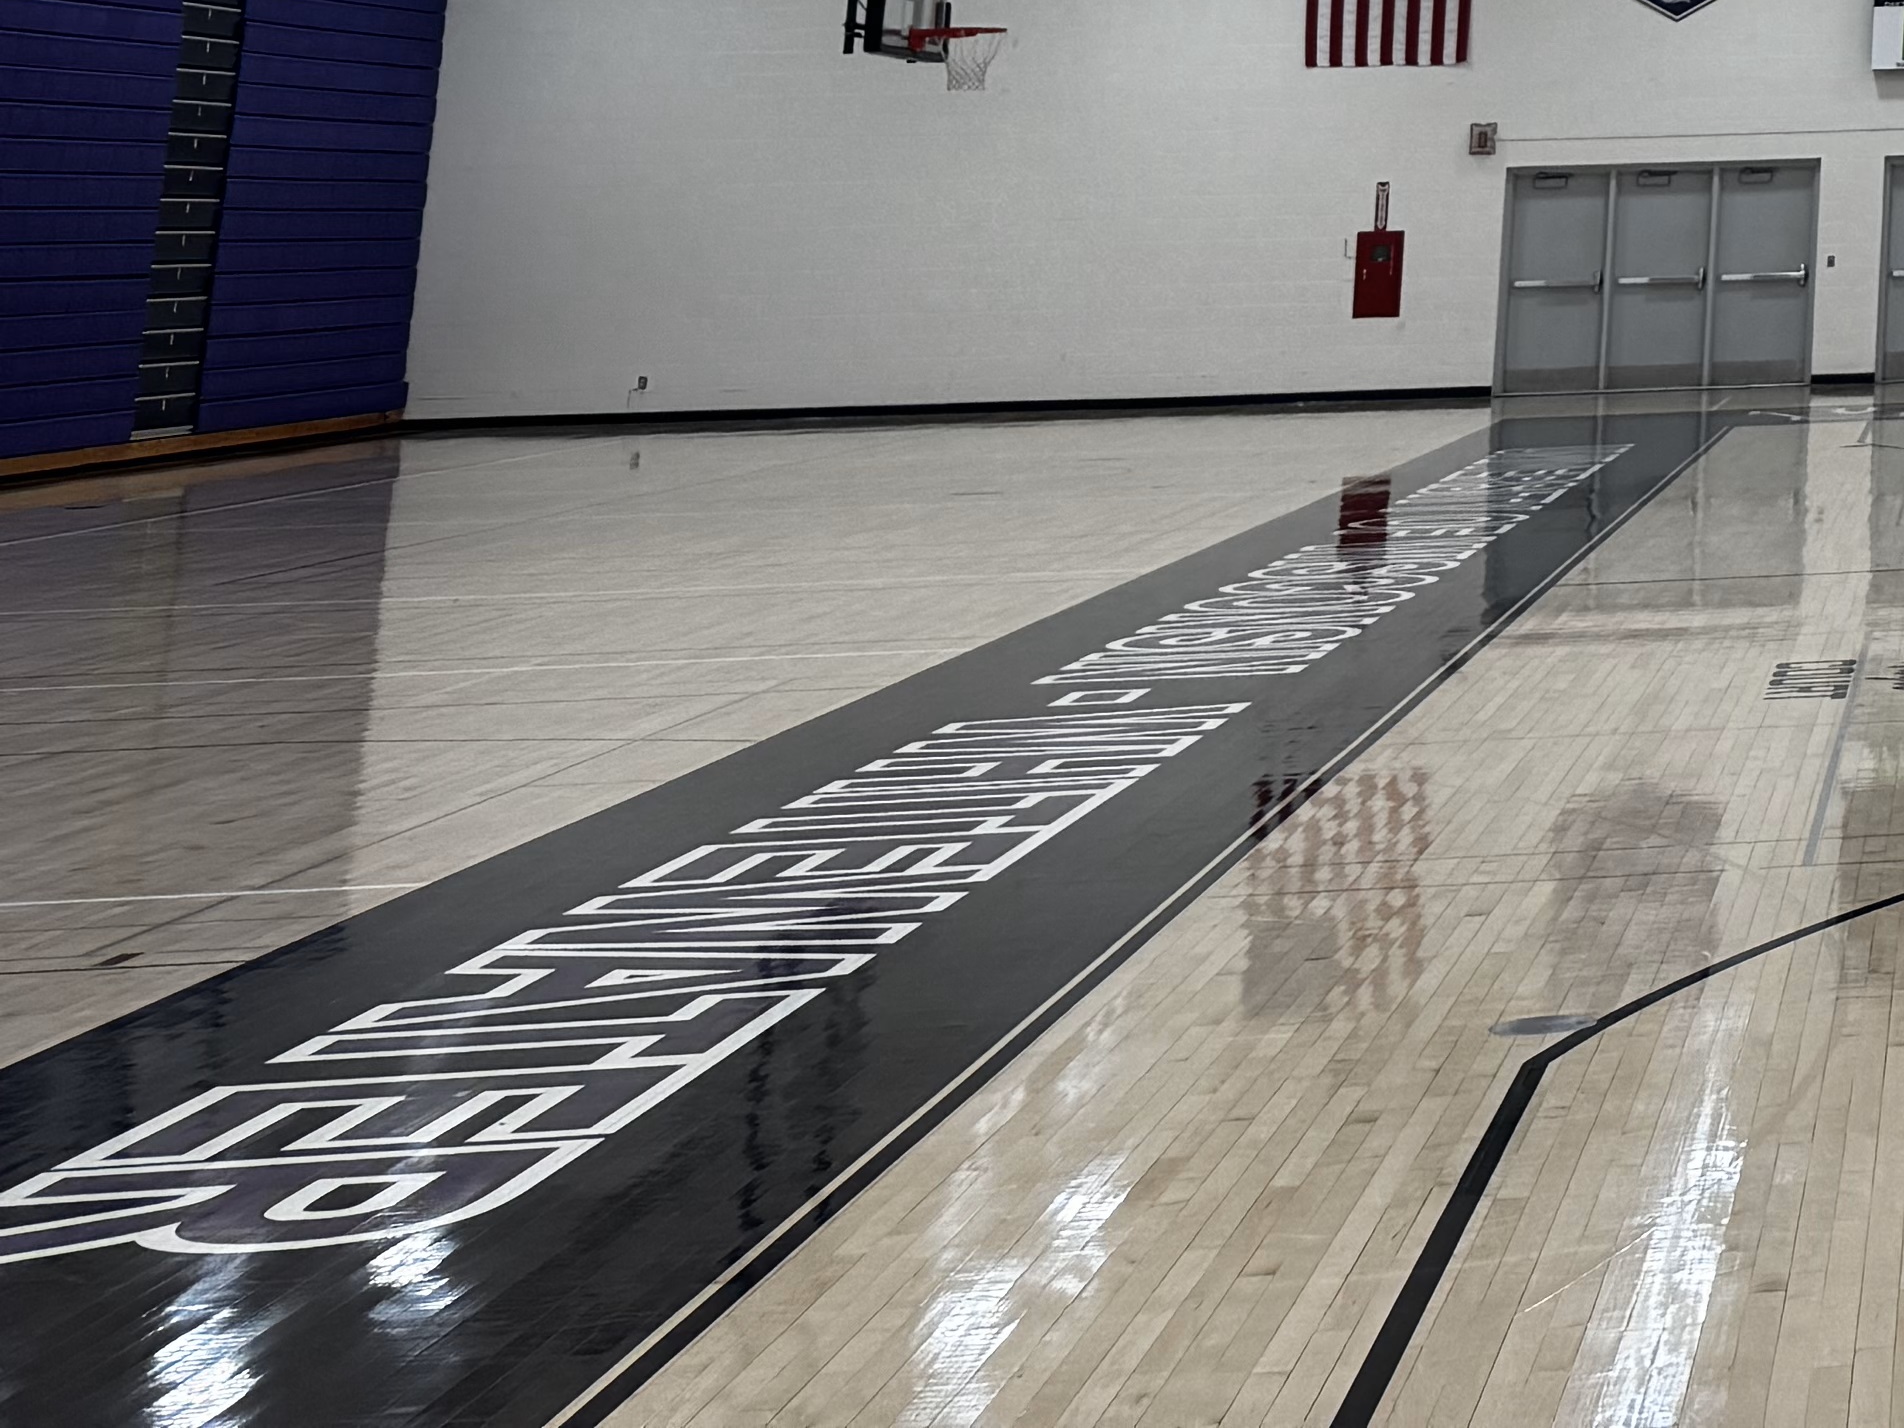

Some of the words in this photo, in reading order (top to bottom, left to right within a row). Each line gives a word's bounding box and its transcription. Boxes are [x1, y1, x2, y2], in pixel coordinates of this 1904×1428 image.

[1030, 535, 1498, 684] WISCONSIN
[1763, 658, 1857, 700] COURT
[0, 701, 1252, 1262] WHITEWATER
